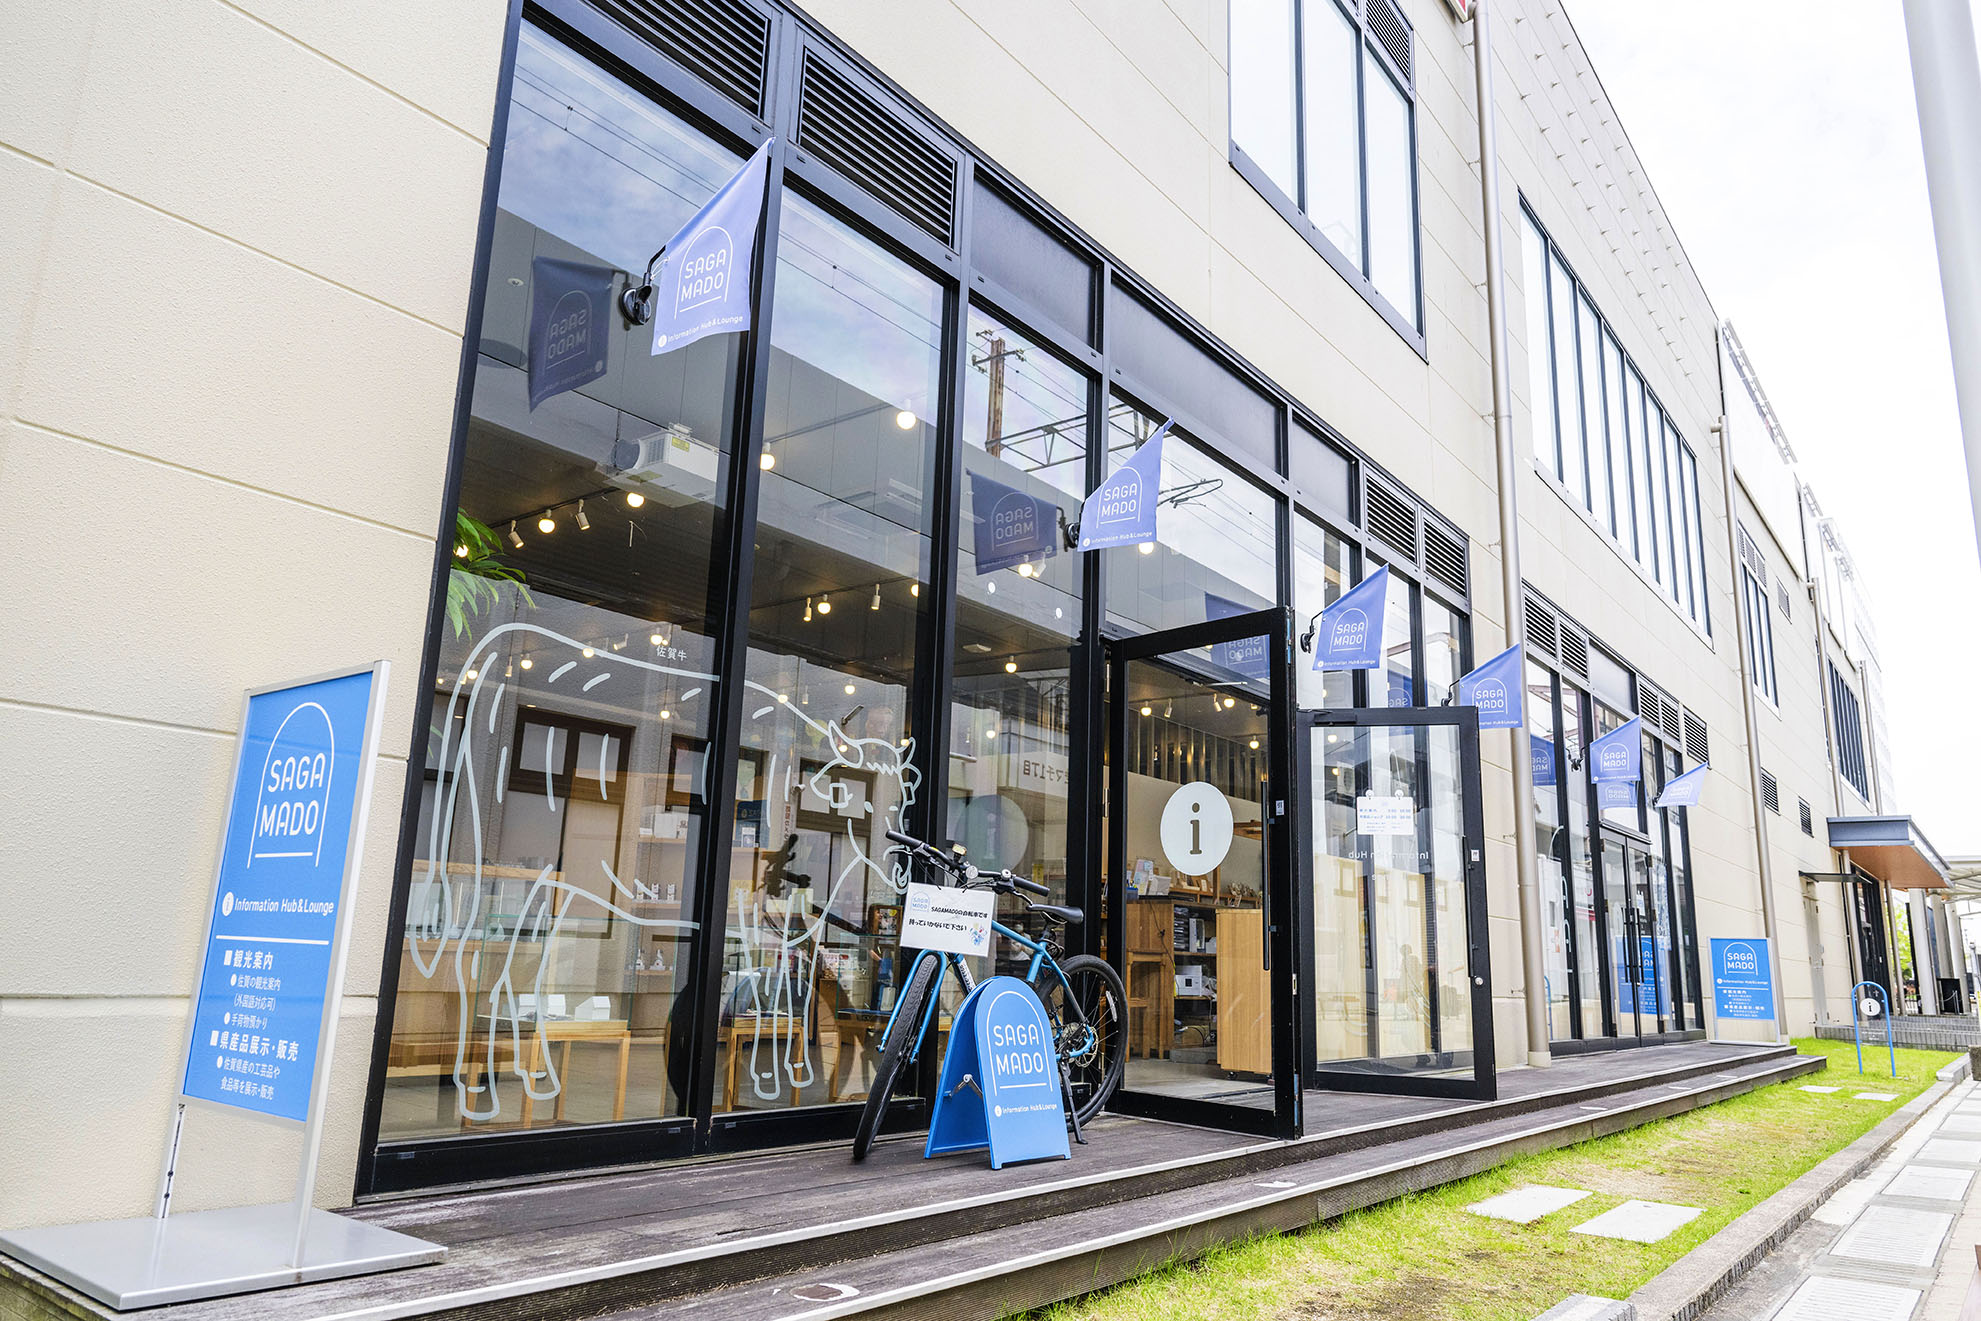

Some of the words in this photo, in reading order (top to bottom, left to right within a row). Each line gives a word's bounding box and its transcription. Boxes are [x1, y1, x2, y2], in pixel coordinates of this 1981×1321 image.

[684, 249, 727, 279] SAGA
[681, 271, 724, 303] MADO
[668, 324, 699, 343] Information
[1103, 483, 1138, 502] SAGA
[1101, 499, 1137, 518] MADO
[1336, 621, 1365, 635] SAGA
[1333, 634, 1363, 647] MADO
[656, 645, 688, 661] 佐賀牛
[1475, 689, 1504, 699] SAGA
[1475, 699, 1504, 709] MADO
[1603, 751, 1627, 760] SAGA
[1603, 758, 1627, 768] MADO
[267, 752, 325, 793] SAGA
[259, 801, 319, 838] MADO
[234, 897, 279, 913] Information
[281, 898, 334, 916] Hub&Lounge
[233, 949, 274, 970] 観光案内
[1727, 952, 1754, 961] SAGA
[1727, 961, 1755, 970] MADO
[993, 1023, 1040, 1048] SAGA
[995, 1052, 1044, 1076] MADO
[1002, 1104, 1029, 1115] Information
